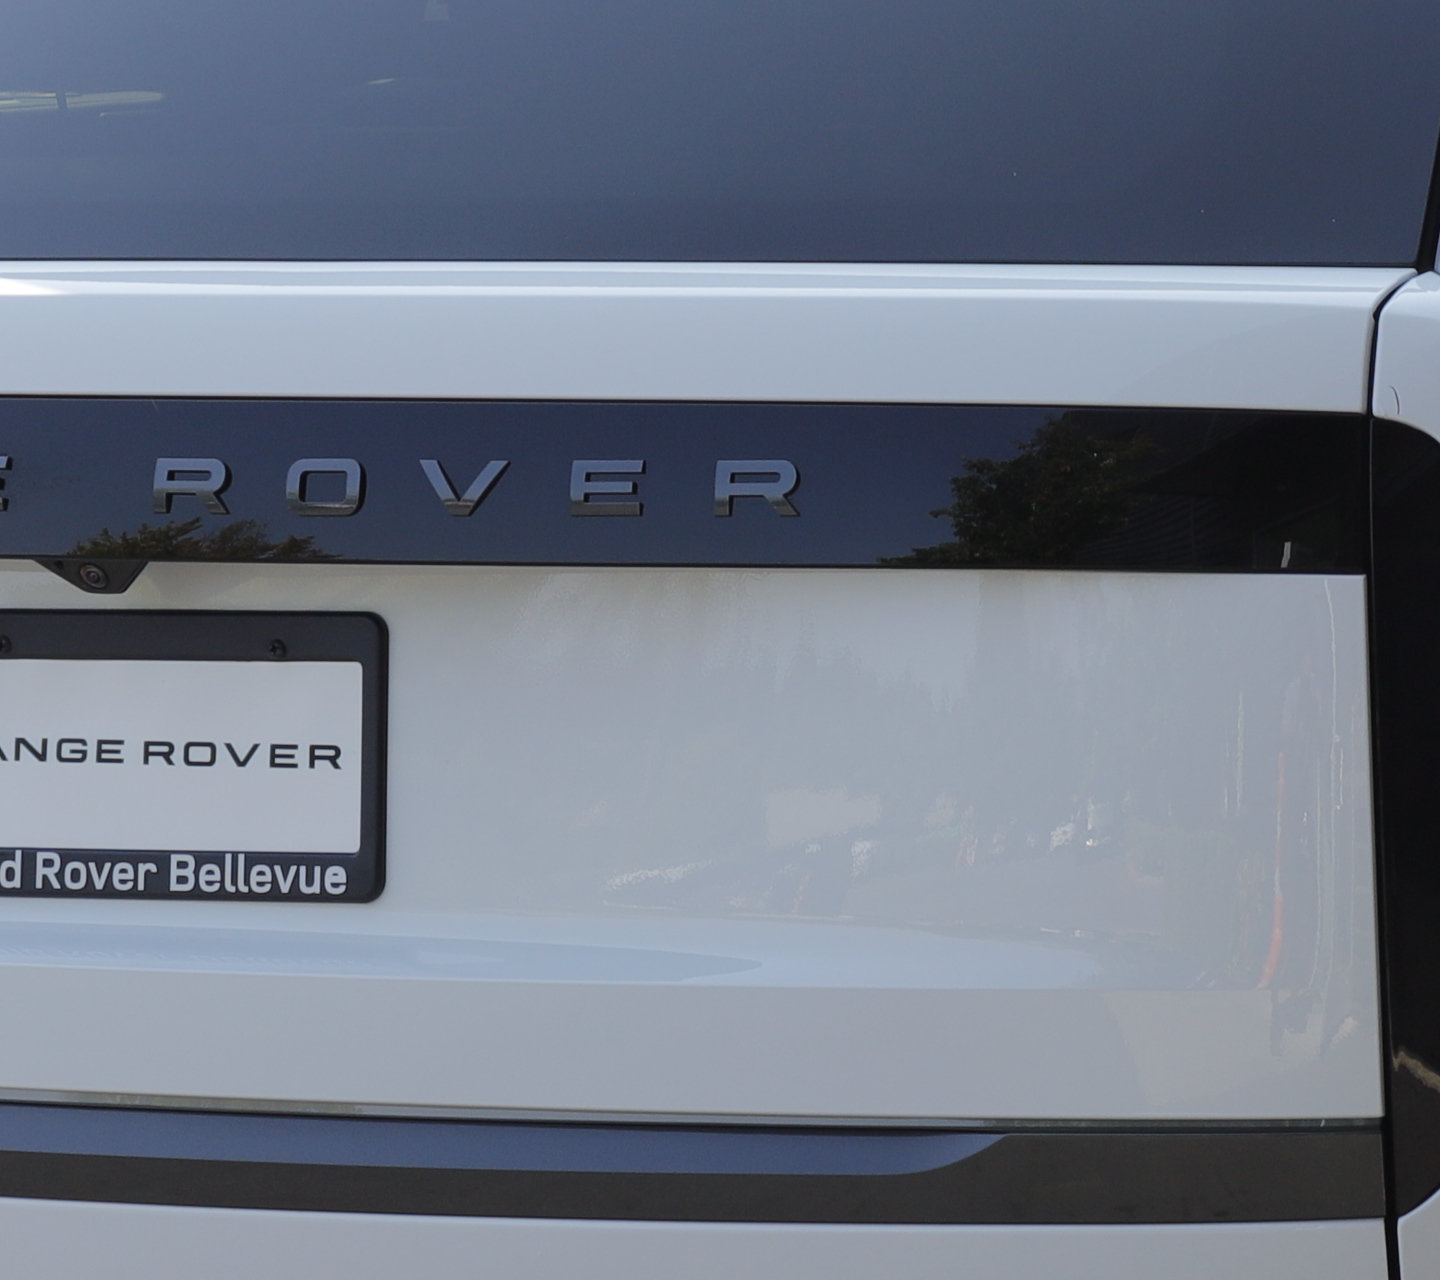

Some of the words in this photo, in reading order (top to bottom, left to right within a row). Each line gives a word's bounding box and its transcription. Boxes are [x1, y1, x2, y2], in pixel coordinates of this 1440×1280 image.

[152, 457, 801, 517] ROVER
[142, 740, 343, 770] ROVER
[34, 851, 158, 892] Rover
[168, 853, 348, 895] Bellevue
